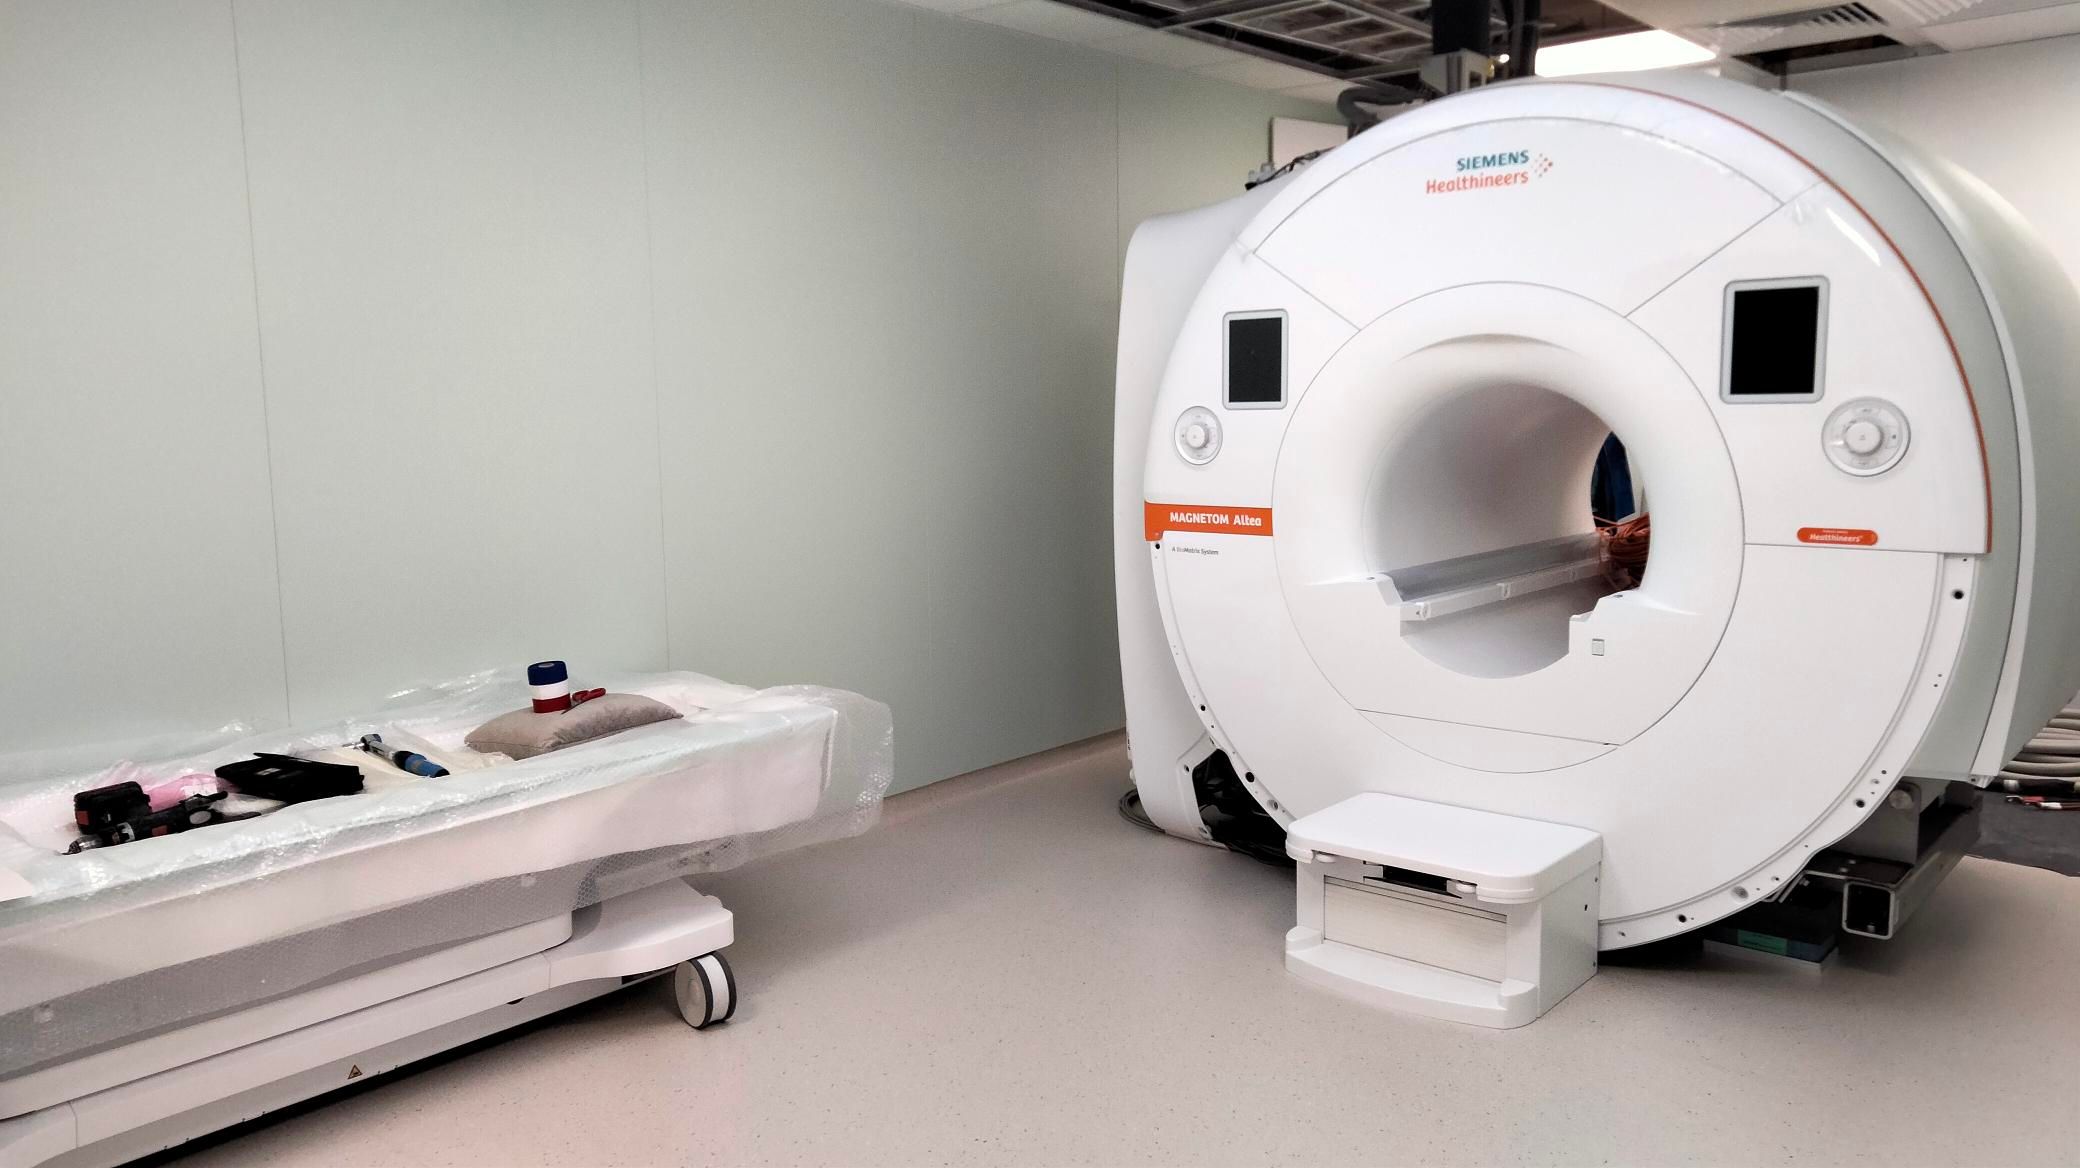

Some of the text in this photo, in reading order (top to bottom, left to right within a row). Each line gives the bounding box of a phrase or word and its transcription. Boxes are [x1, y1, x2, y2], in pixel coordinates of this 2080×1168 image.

[1457, 150, 1530, 172] SIEMENS
[1426, 171, 1530, 194] Healthineers
[1169, 511, 1263, 527] MAGNETOM Altea
